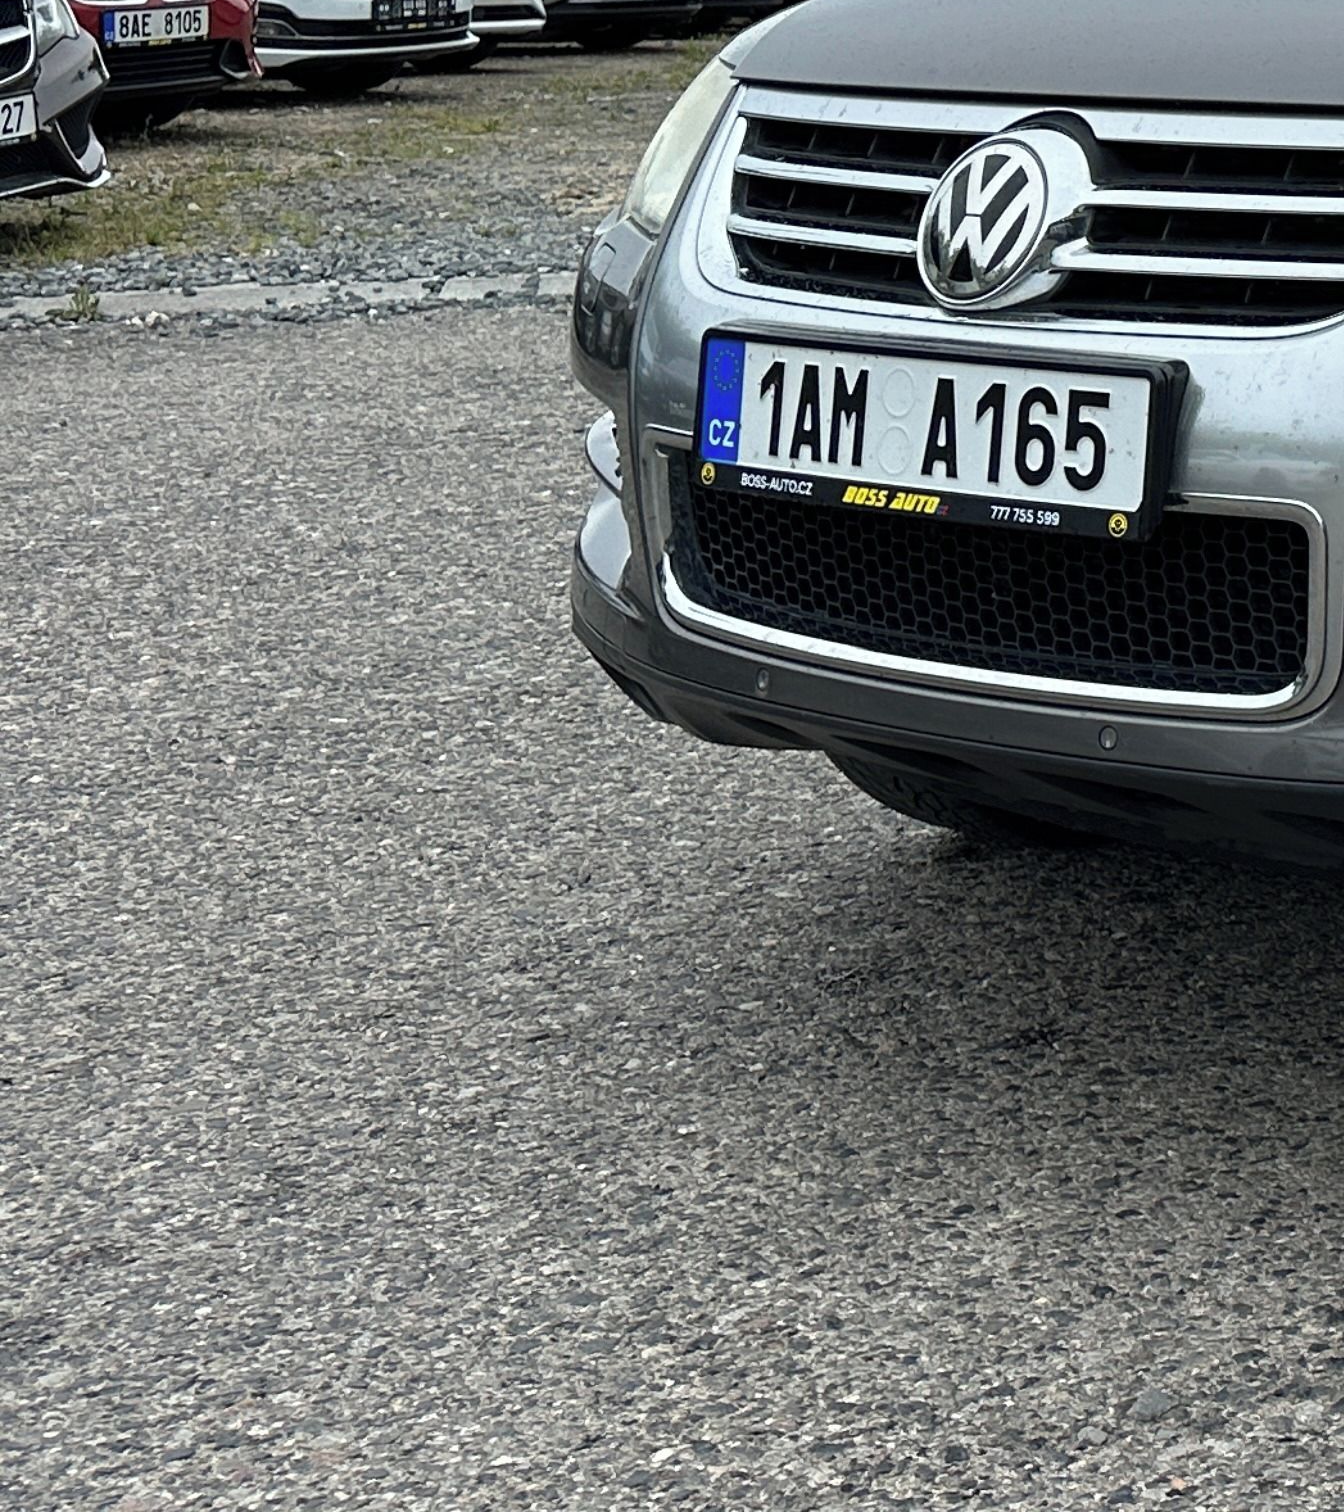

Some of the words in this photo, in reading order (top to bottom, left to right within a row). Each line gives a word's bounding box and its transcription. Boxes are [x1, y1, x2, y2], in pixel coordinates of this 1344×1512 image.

[119, 13, 152, 39] 8AE
[164, 9, 202, 35] 8105
[1, 100, 24, 135] 27
[708, 418, 736, 448] CZ
[757, 361, 870, 468] 1AM
[919, 376, 1111, 492] A165
[741, 472, 813, 496] BOSS-AUTO.CZ
[842, 485, 889, 508] BOSS
[888, 492, 941, 514] AUTO
[990, 505, 1011, 521] 777
[1012, 507, 1034, 524] 755
[1036, 510, 1060, 526] 599
